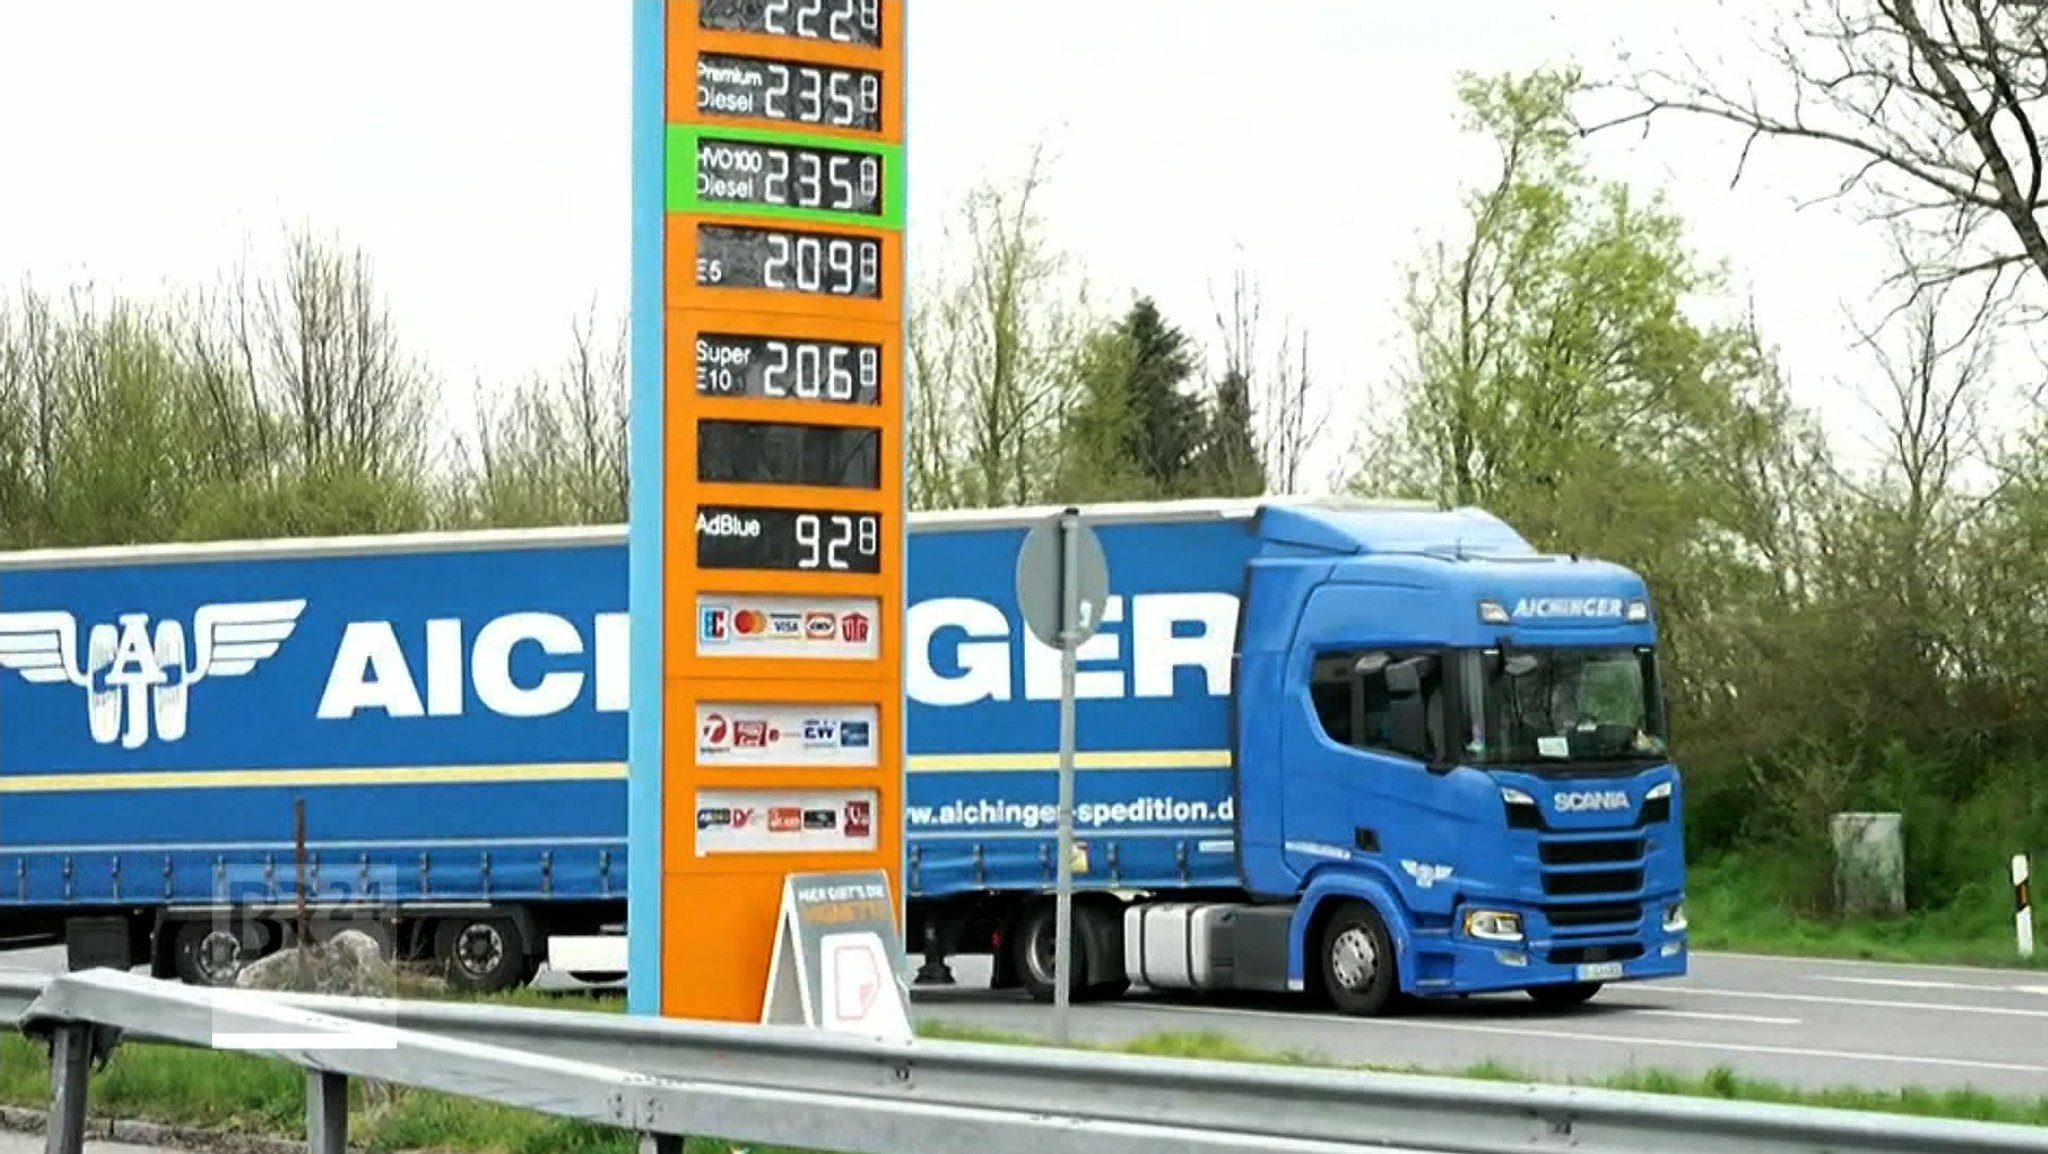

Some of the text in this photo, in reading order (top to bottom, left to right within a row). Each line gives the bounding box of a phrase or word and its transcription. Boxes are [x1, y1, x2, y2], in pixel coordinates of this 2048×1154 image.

[696, 61, 763, 87] Premium
[696, 85, 753, 113] Diesel
[696, 147, 762, 173] HVO100
[696, 173, 753, 198] Diesel
[696, 340, 751, 366] Super
[696, 367, 732, 391] E10
[696, 513, 761, 537] AdBlue
[774, 620, 799, 632] VISA
[1554, 792, 1631, 812] SCANIA
